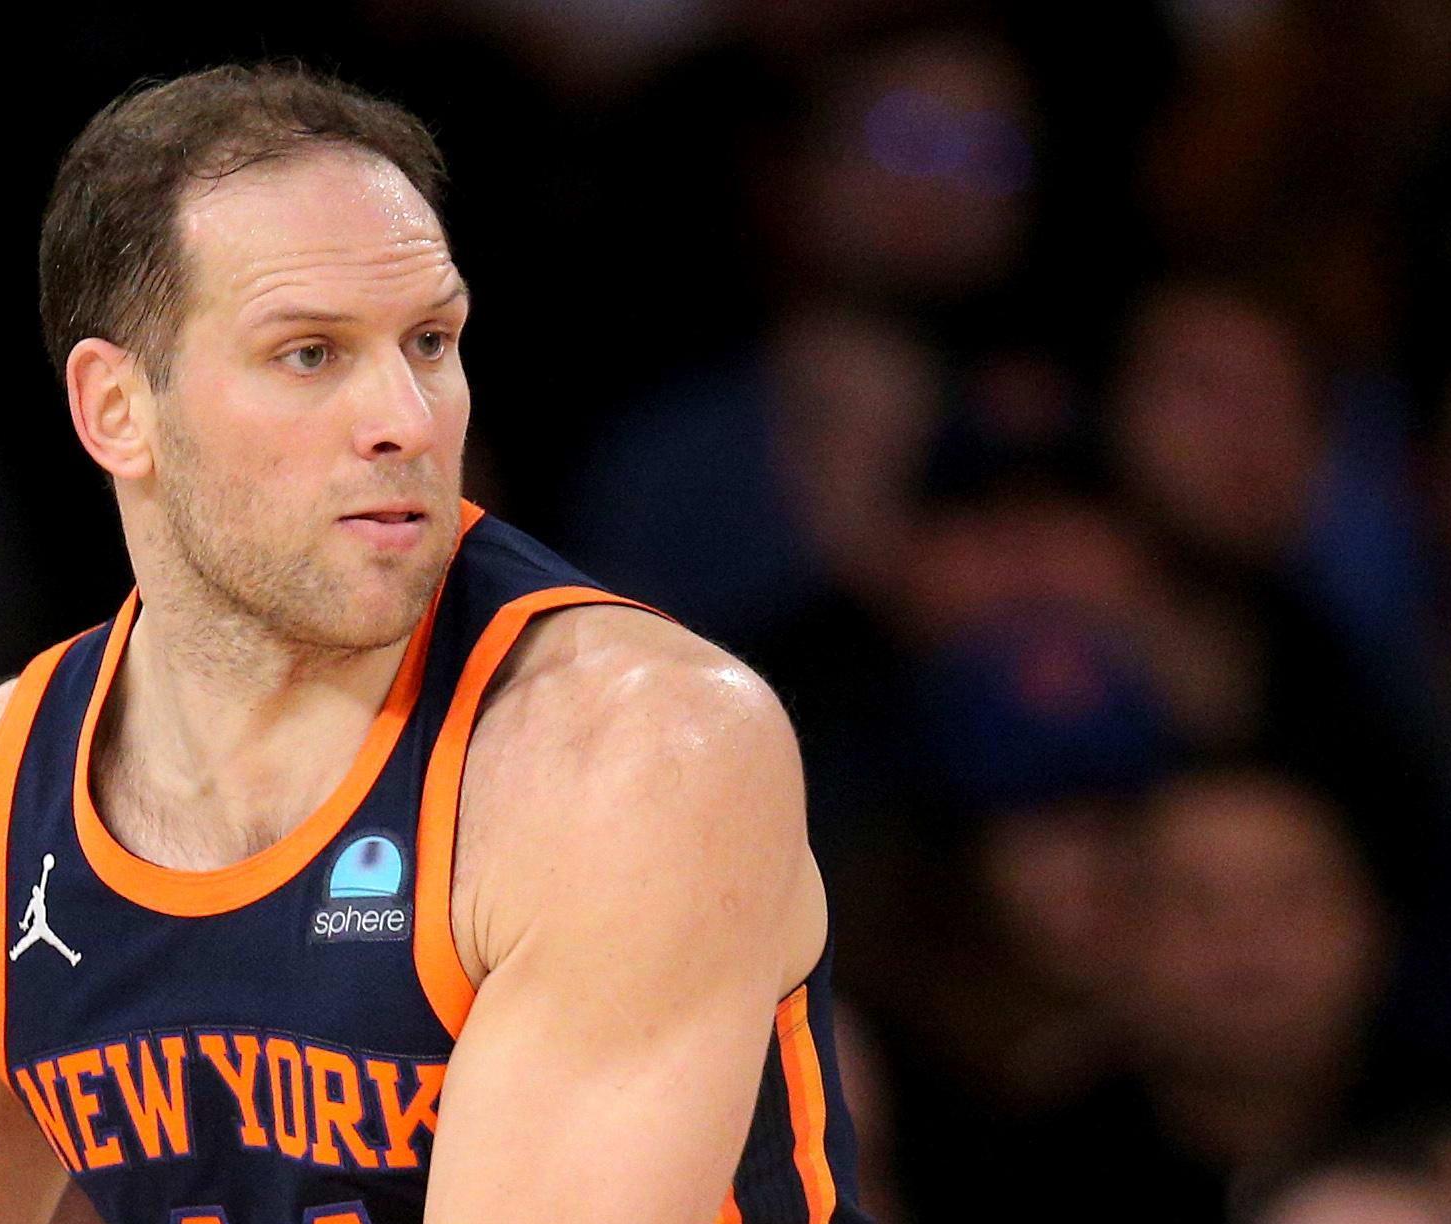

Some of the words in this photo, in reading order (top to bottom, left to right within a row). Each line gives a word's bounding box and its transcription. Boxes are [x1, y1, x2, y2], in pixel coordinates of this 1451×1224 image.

[314, 905, 405, 939] sphere
[12, 1033, 194, 1174] NEW
[194, 1029, 449, 1171] YORK
